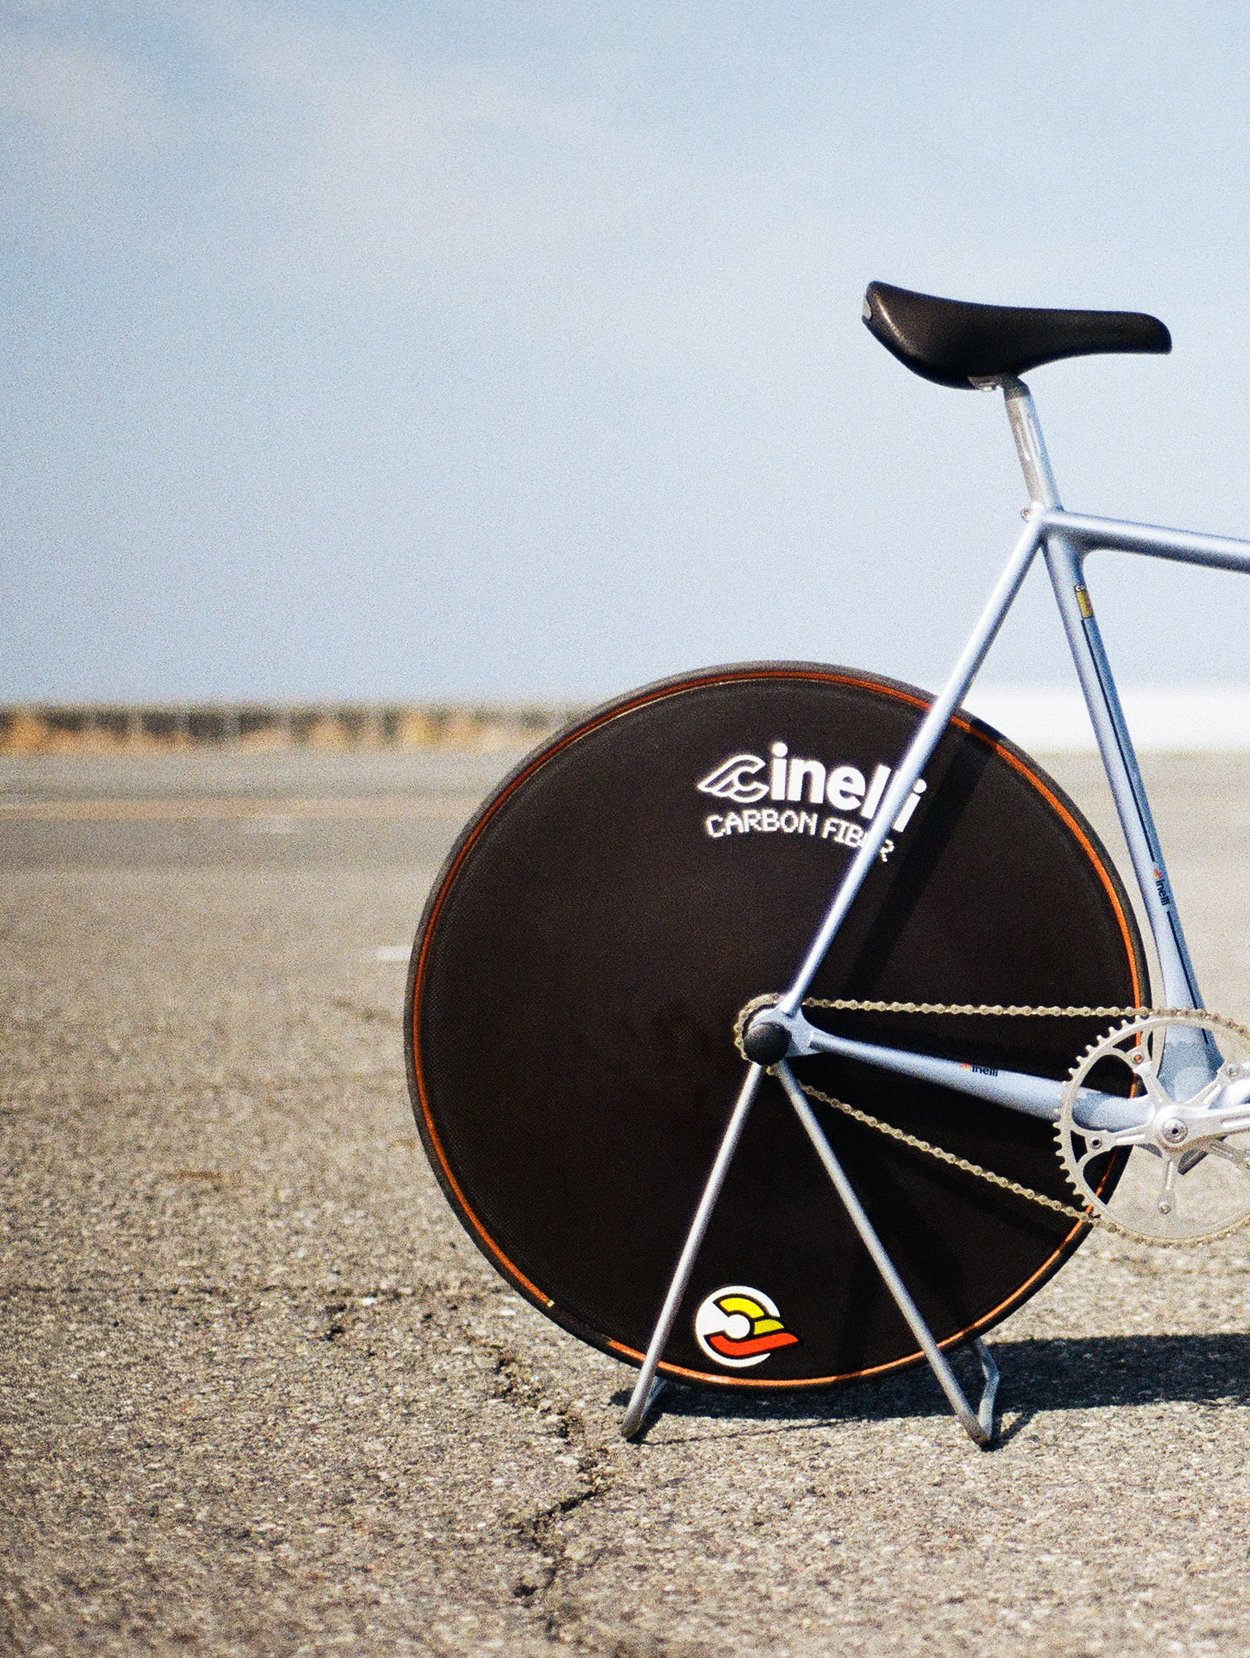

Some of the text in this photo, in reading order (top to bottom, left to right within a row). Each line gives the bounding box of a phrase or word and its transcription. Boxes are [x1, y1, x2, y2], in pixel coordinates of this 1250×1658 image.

[697, 742, 926, 832] Cineli
[705, 808, 895, 862] CARBON FIBR
